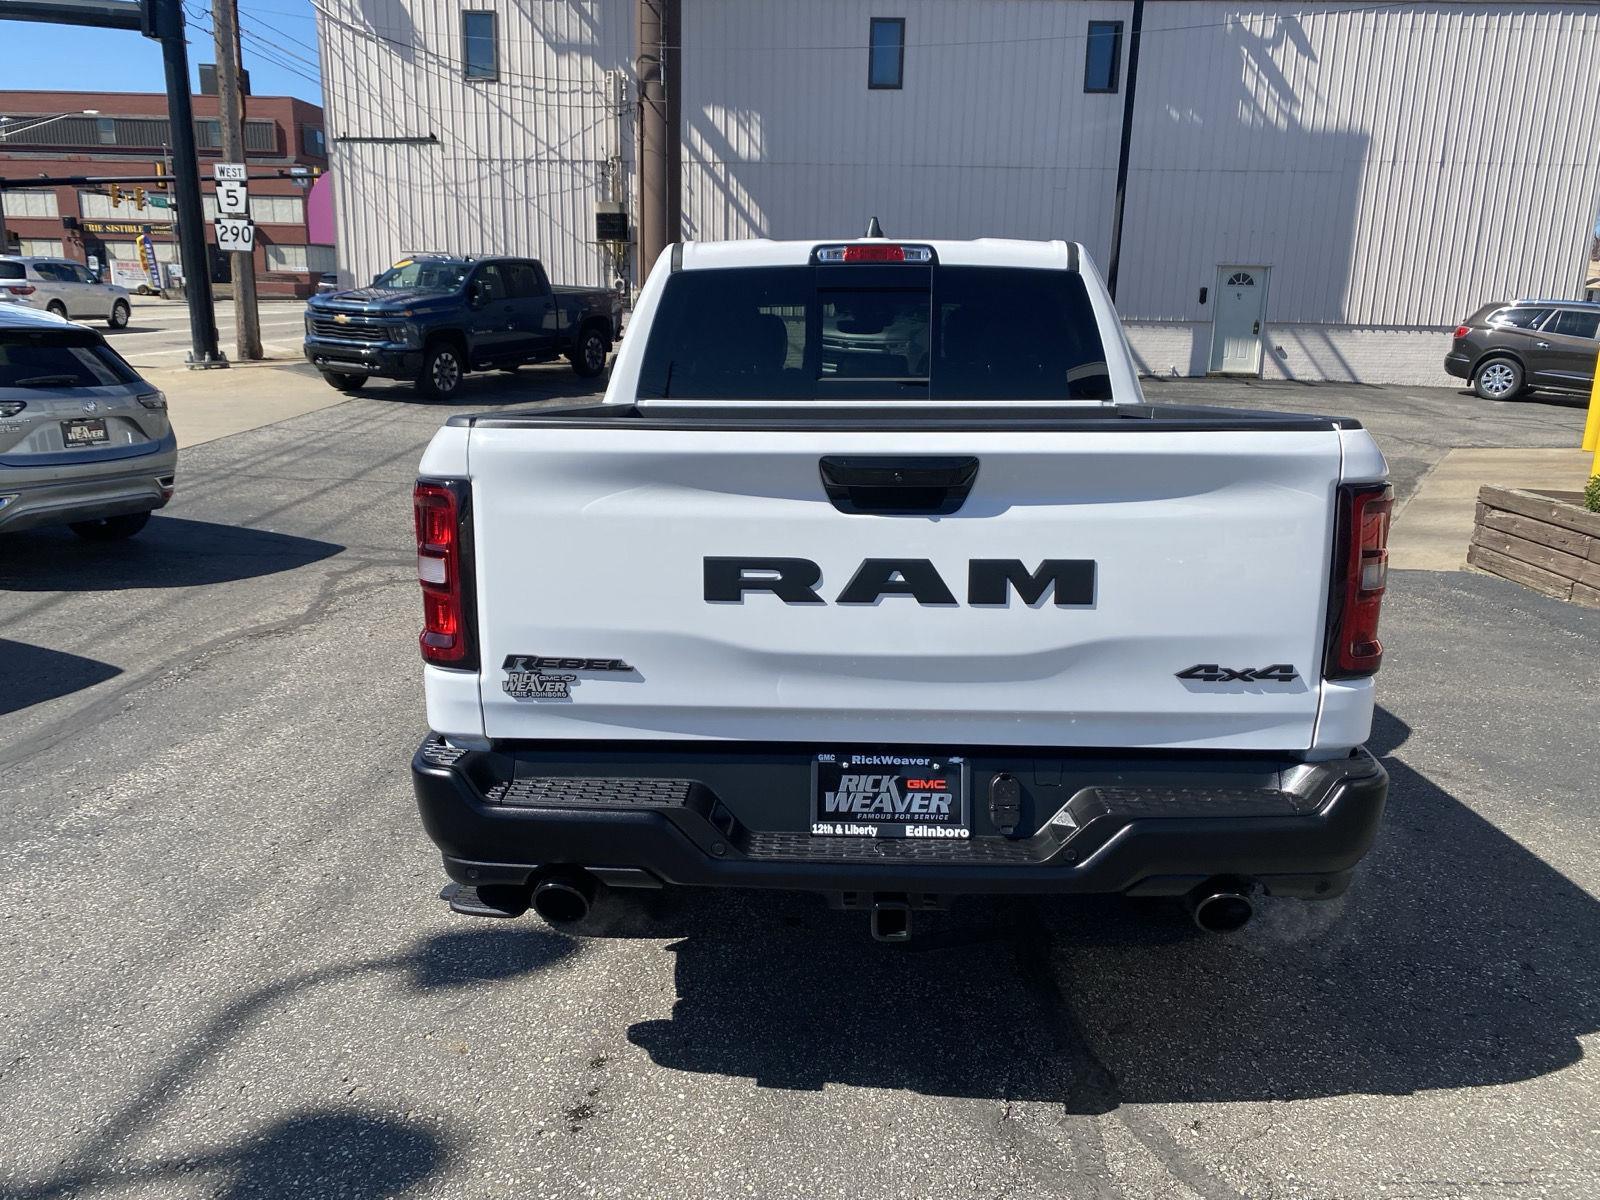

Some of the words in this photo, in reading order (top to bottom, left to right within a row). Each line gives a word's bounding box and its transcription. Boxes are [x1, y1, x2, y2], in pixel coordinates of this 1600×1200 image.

[218, 166, 242, 177] WEST
[226, 189, 239, 207] 5
[219, 225, 252, 243] 290
[703, 556, 1095, 605] RAM
[502, 654, 635, 672] REBEL
[509, 673, 541, 682] RICK
[1173, 664, 1300, 682] 4x4
[503, 681, 566, 692] WEAVER
[851, 755, 930, 766] RickWeaver
[838, 775, 901, 793] RICK
[907, 779, 947, 789] GMC
[825, 792, 953, 814] WEAVER
[812, 824, 834, 834] 12th
[835, 824, 843, 835] &
[845, 825, 878, 837] Liberty
[905, 825, 970, 838] Edinboro
